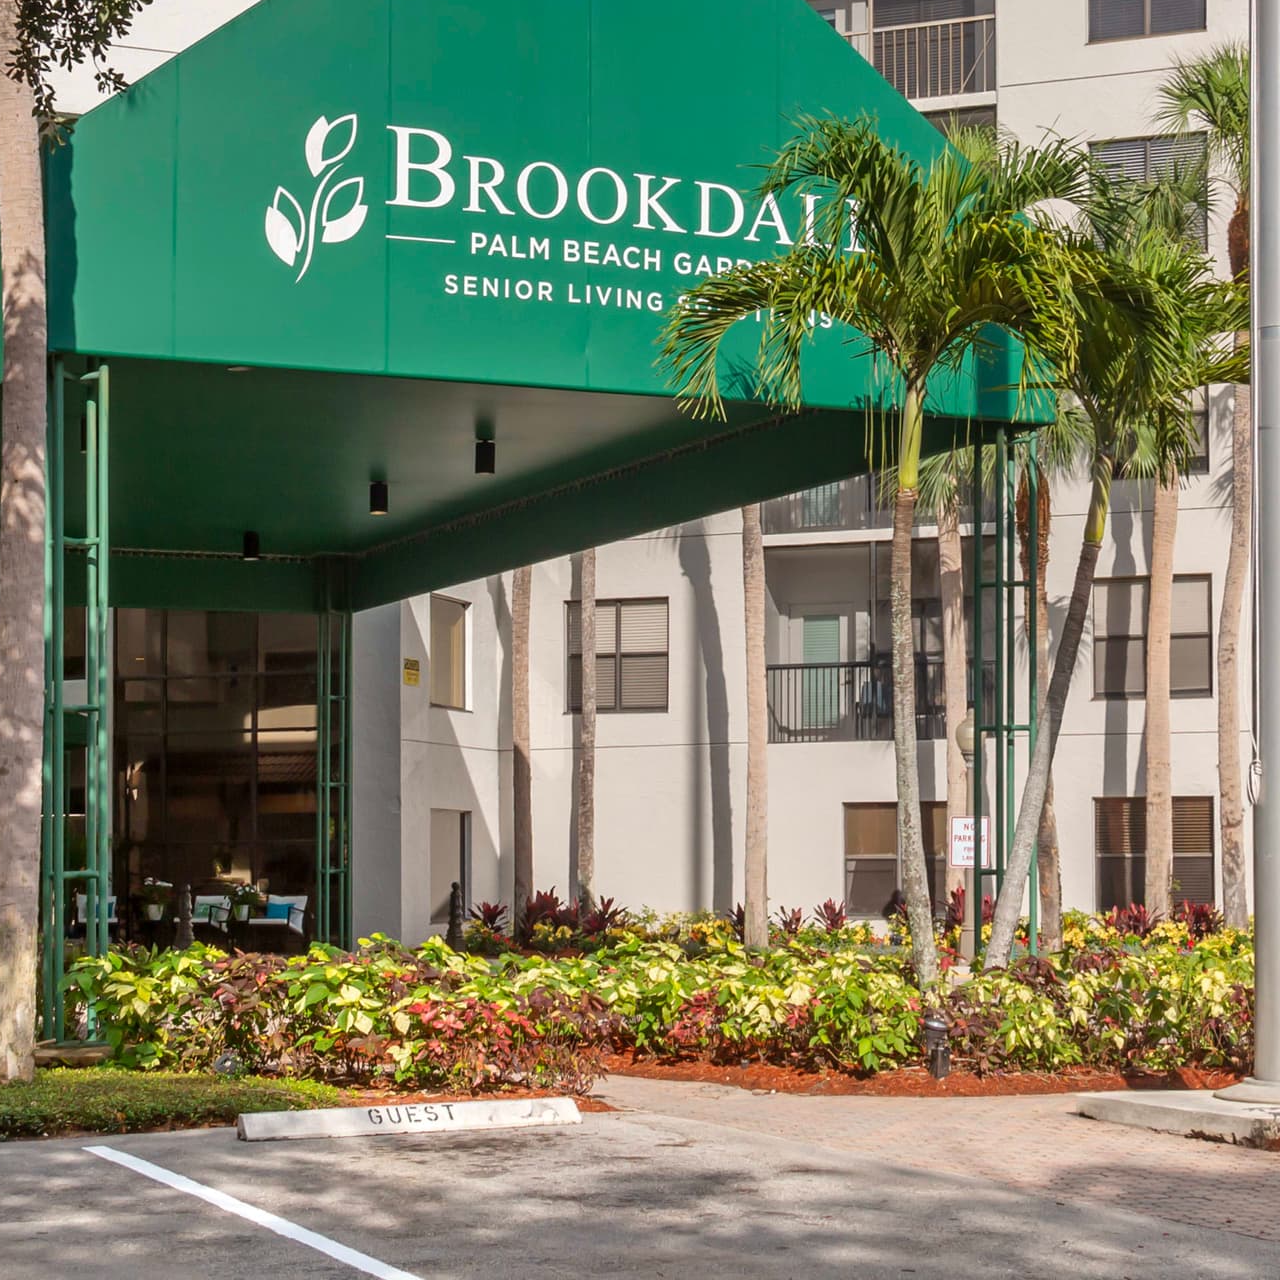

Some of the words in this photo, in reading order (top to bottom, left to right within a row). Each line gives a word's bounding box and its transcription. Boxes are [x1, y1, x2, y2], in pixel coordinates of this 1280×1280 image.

[470, 231, 551, 261] PALM
[563, 239, 662, 272] BEACH
[444, 274, 554, 302] SENIOR
[567, 283, 664, 312] LIVING
[367, 1103, 455, 1125] GUEST
